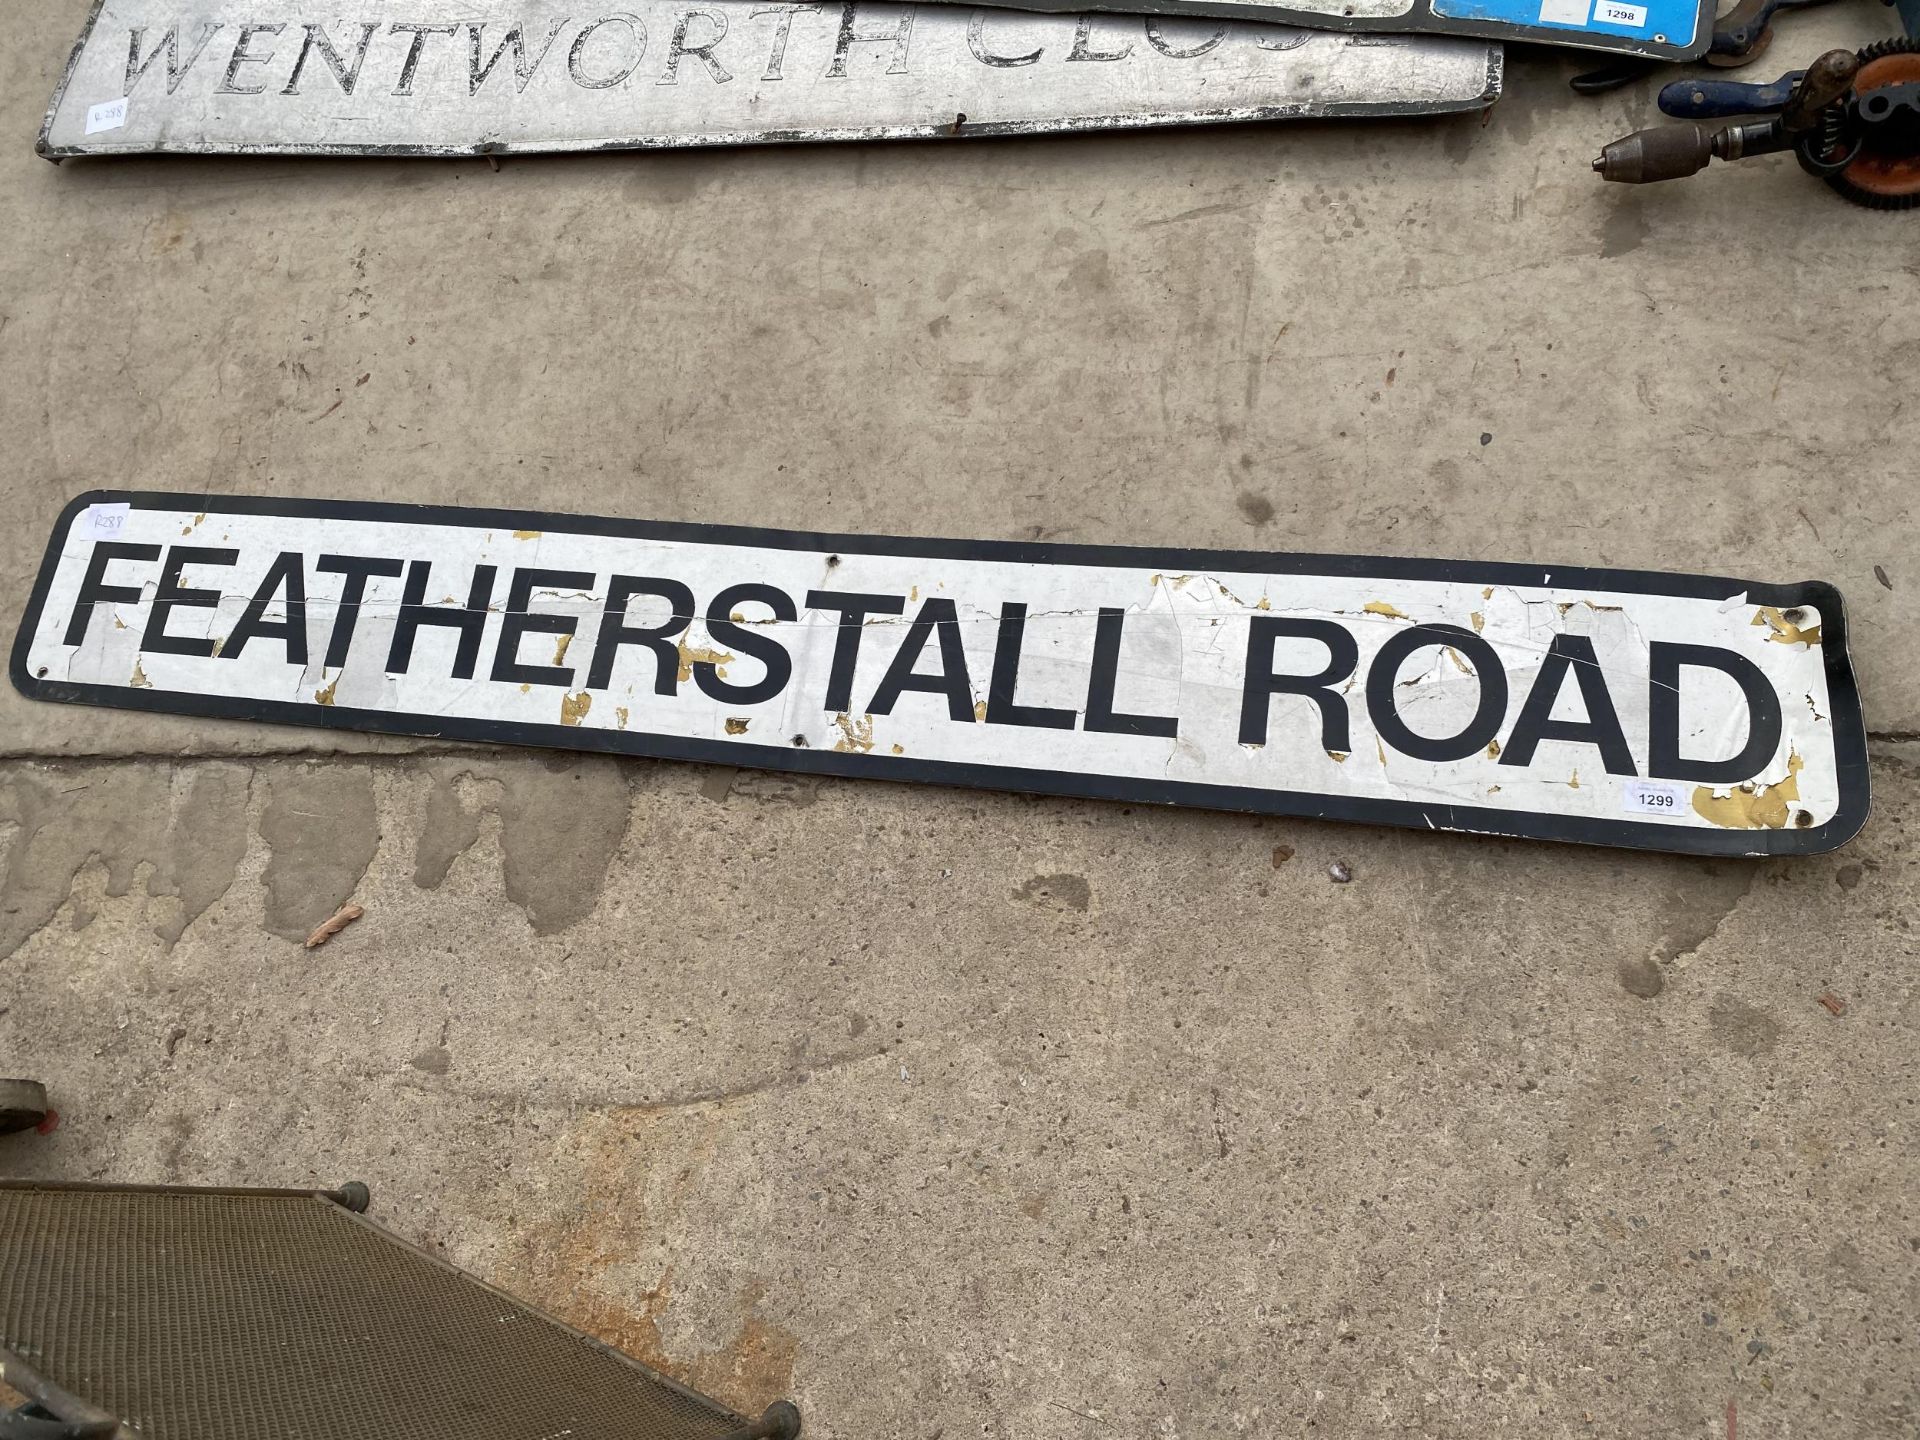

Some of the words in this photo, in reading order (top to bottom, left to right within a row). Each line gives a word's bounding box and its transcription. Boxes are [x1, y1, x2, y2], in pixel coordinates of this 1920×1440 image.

[1607, 9, 1635, 21] 1298
[123, 2, 917, 97] WENTWORTH
[966, 11, 1410, 68] CLO
[62, 541, 1179, 739] FEATHERSTALL
[1237, 615, 1783, 785] ROAD
[1639, 793, 1674, 807] 1299
